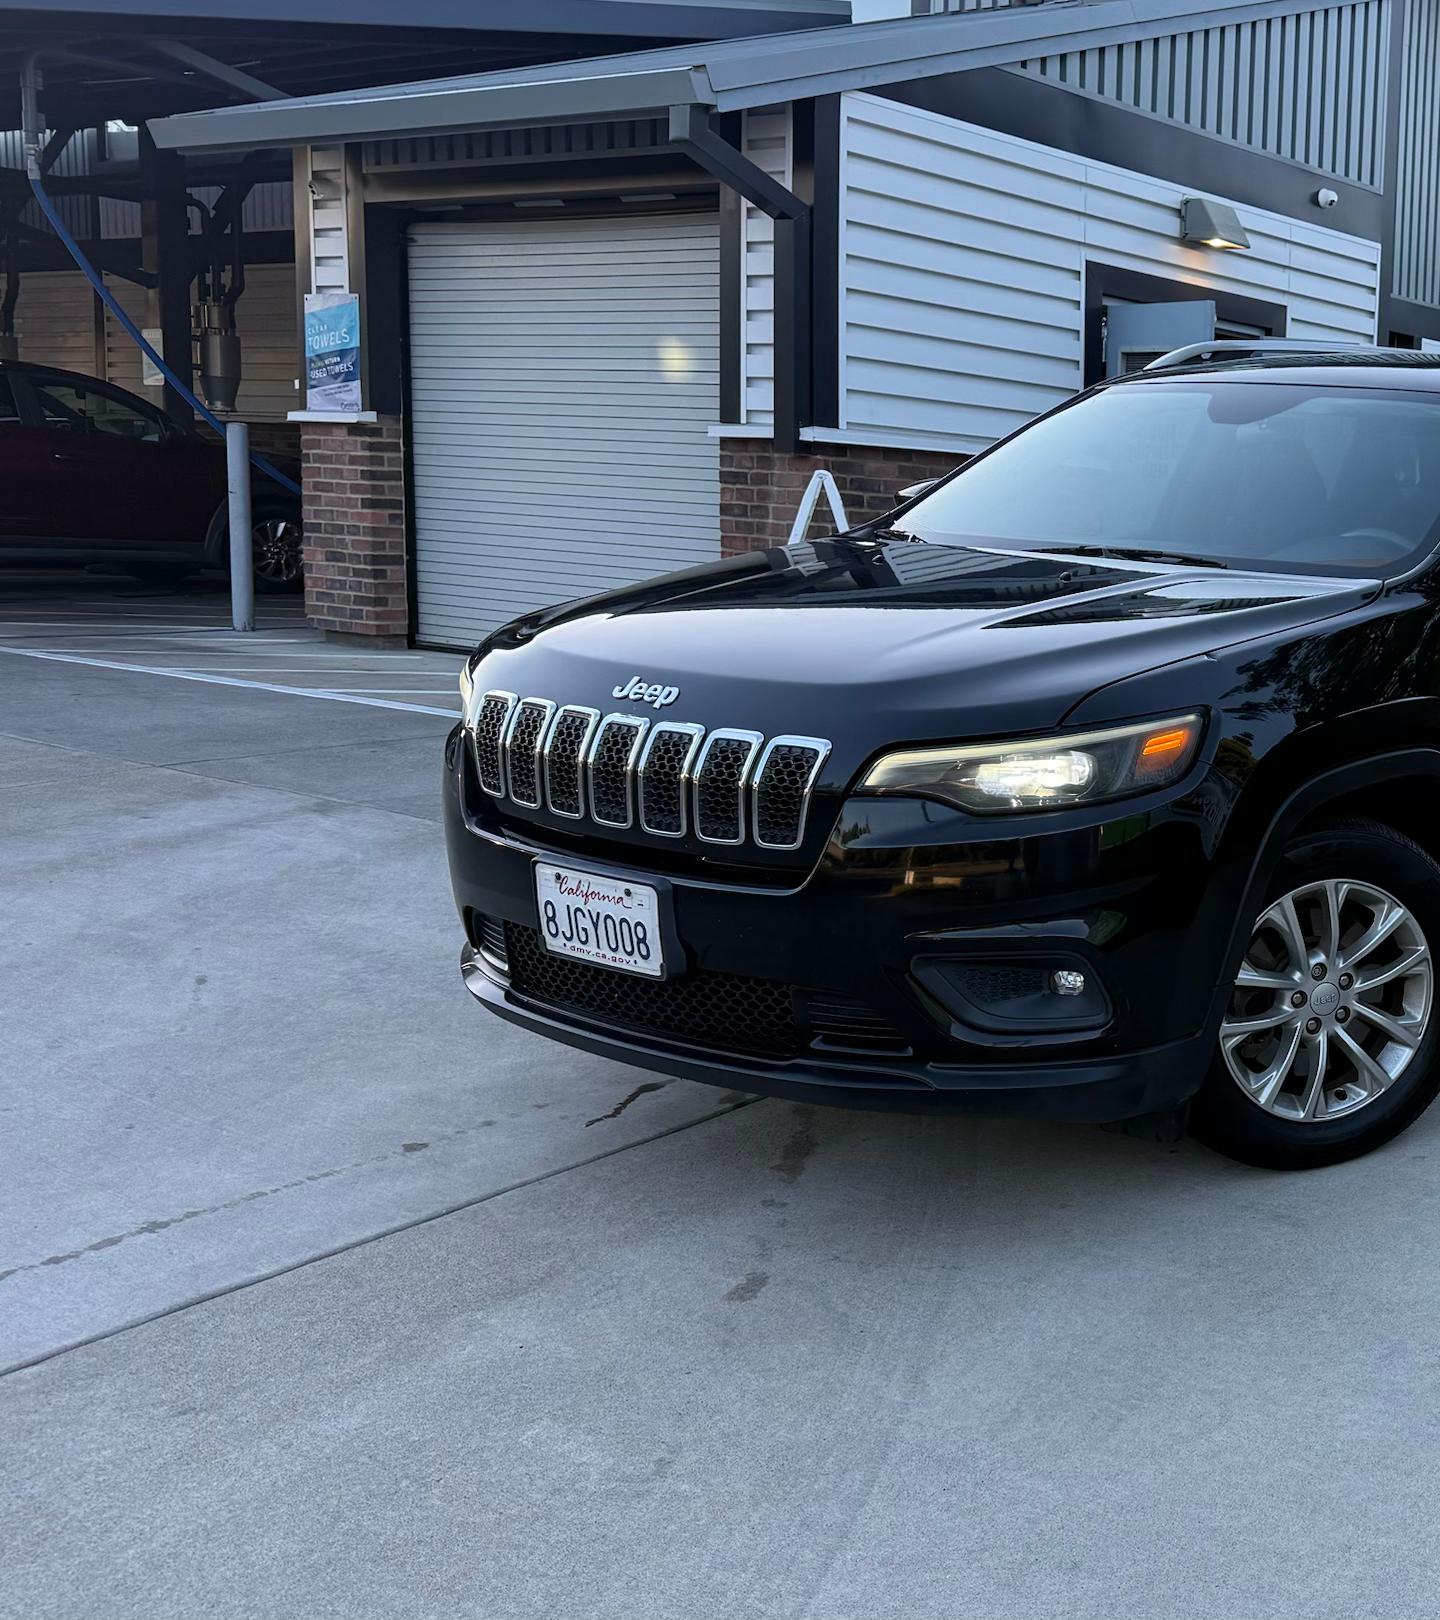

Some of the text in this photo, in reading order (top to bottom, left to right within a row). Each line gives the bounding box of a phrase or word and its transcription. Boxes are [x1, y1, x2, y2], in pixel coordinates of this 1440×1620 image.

[308, 328, 350, 350] TOWELS
[310, 367, 328, 379] USED
[327, 361, 354, 375] TOWELS
[612, 675, 680, 710] Jeep
[559, 875, 632, 909] California
[544, 899, 651, 960] 8JGY008
[569, 944, 631, 965] dmv.ca.gov
